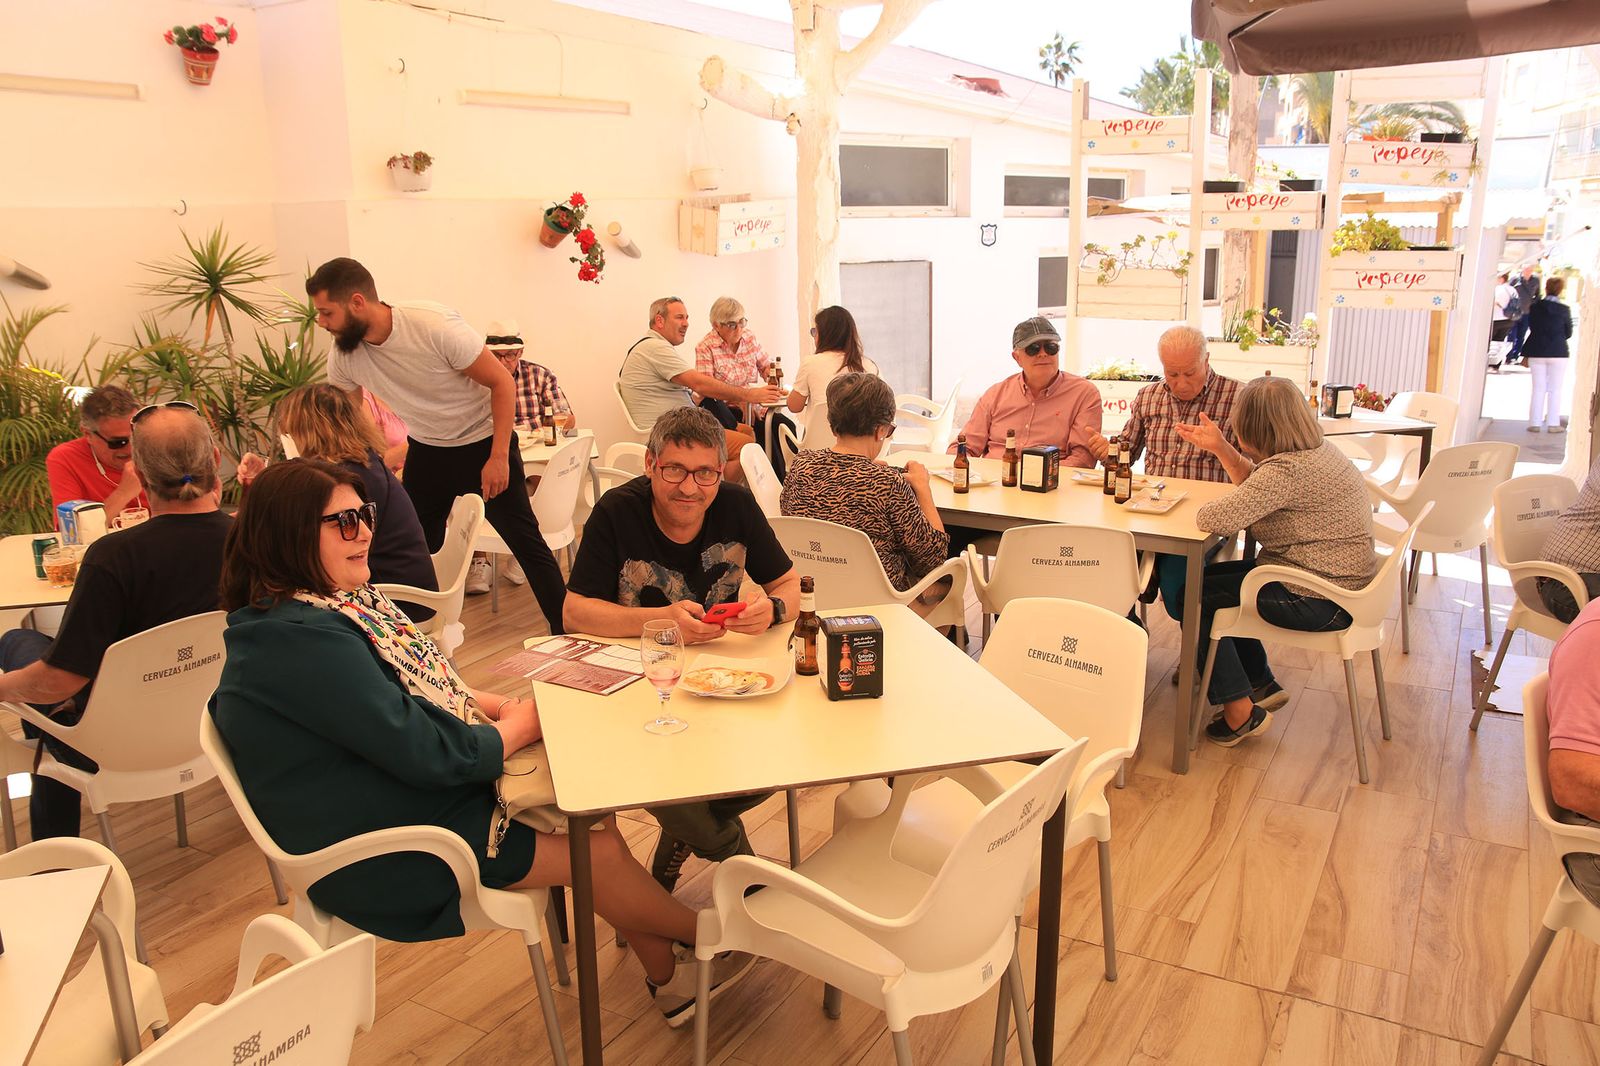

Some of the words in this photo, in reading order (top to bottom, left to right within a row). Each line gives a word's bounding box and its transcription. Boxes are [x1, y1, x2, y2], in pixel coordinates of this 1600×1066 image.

[1102, 119, 1165, 136] Popeye
[1371, 144, 1445, 165] Popeye
[1224, 193, 1291, 211] Popeye
[1355, 271, 1427, 289] Popeye
[790, 549, 816, 561] CERVEZAS
[816, 555, 848, 565] ALHAMBRA
[1031, 557, 1063, 567] CERVEZAS
[1064, 559, 1100, 567] ALHAMBRA
[143, 665, 181, 682] CERVEZAS
[183, 652, 221, 672] ALHAMBRA
[394, 655, 418, 676] BIMBA
[420, 671, 426, 679] Y
[1027, 648, 1063, 666] CERVEZAS
[1064, 657, 1103, 676] ALHAMBRA
[253, 1024, 311, 1066] HAMBRA
